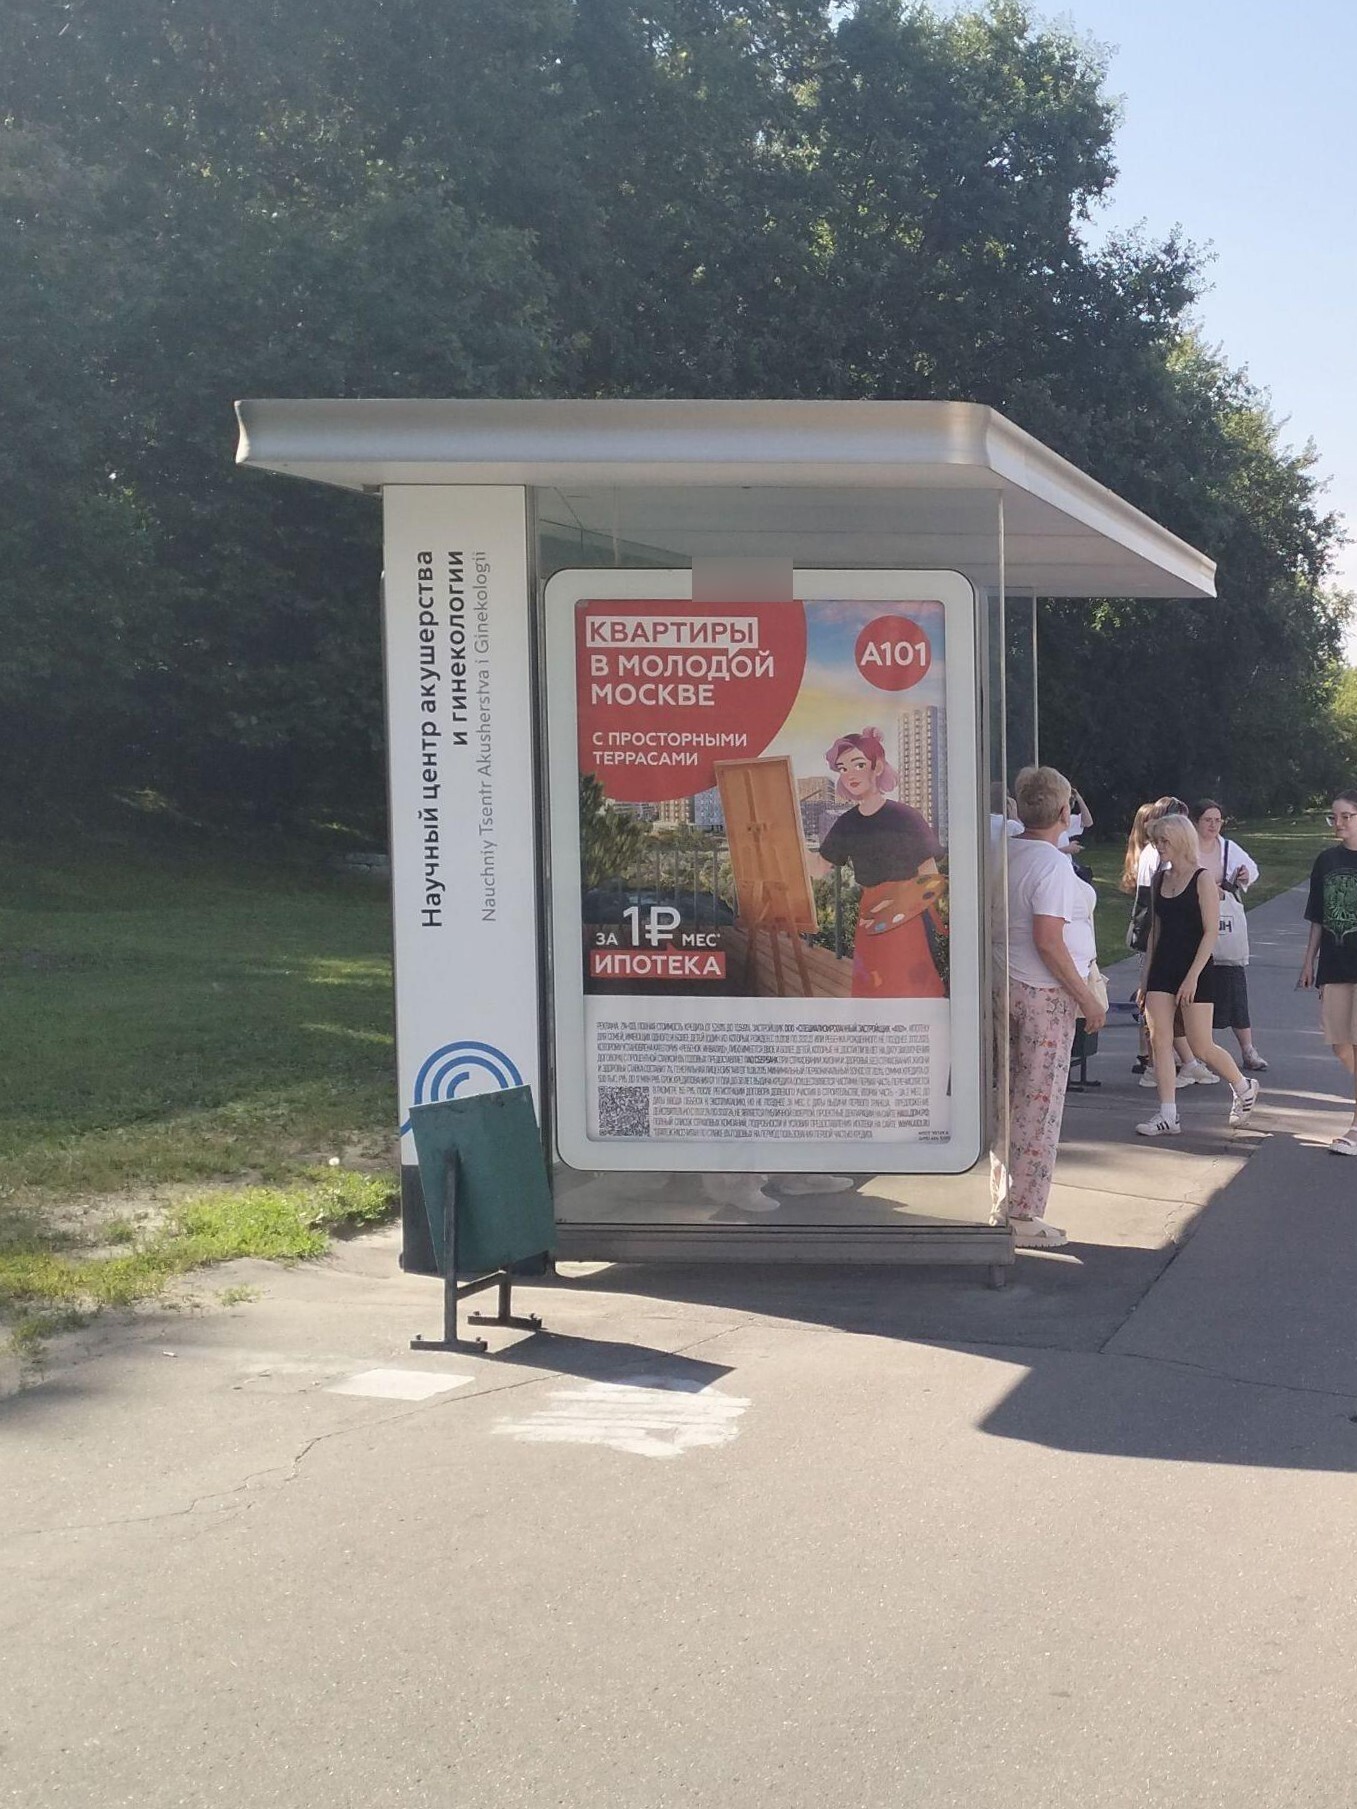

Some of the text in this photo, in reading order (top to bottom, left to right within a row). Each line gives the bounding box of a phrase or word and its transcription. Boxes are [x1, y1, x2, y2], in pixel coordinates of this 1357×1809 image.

[472, 551, 491, 654] Ginekologii
[590, 621, 754, 644] КВАРТИРЫ
[447, 551, 468, 746] и гинекологии
[859, 641, 927, 667] А101
[591, 650, 774, 681] В МОЛОДОЙ
[591, 683, 715, 706] МОСКВЕ
[475, 669, 492, 777] Akusherstva
[417, 551, 446, 927] Научный центр акушерства
[592, 731, 748, 747] С ПРОСТОРНЫМИ
[593, 751, 698, 766] ТЕРРАСАМИ
[478, 780, 494, 836] Tsentr
[480, 839, 498, 922] Nauchniy
[595, 932, 619, 946] ЗА
[595, 954, 722, 975] ИПОТЕКА
